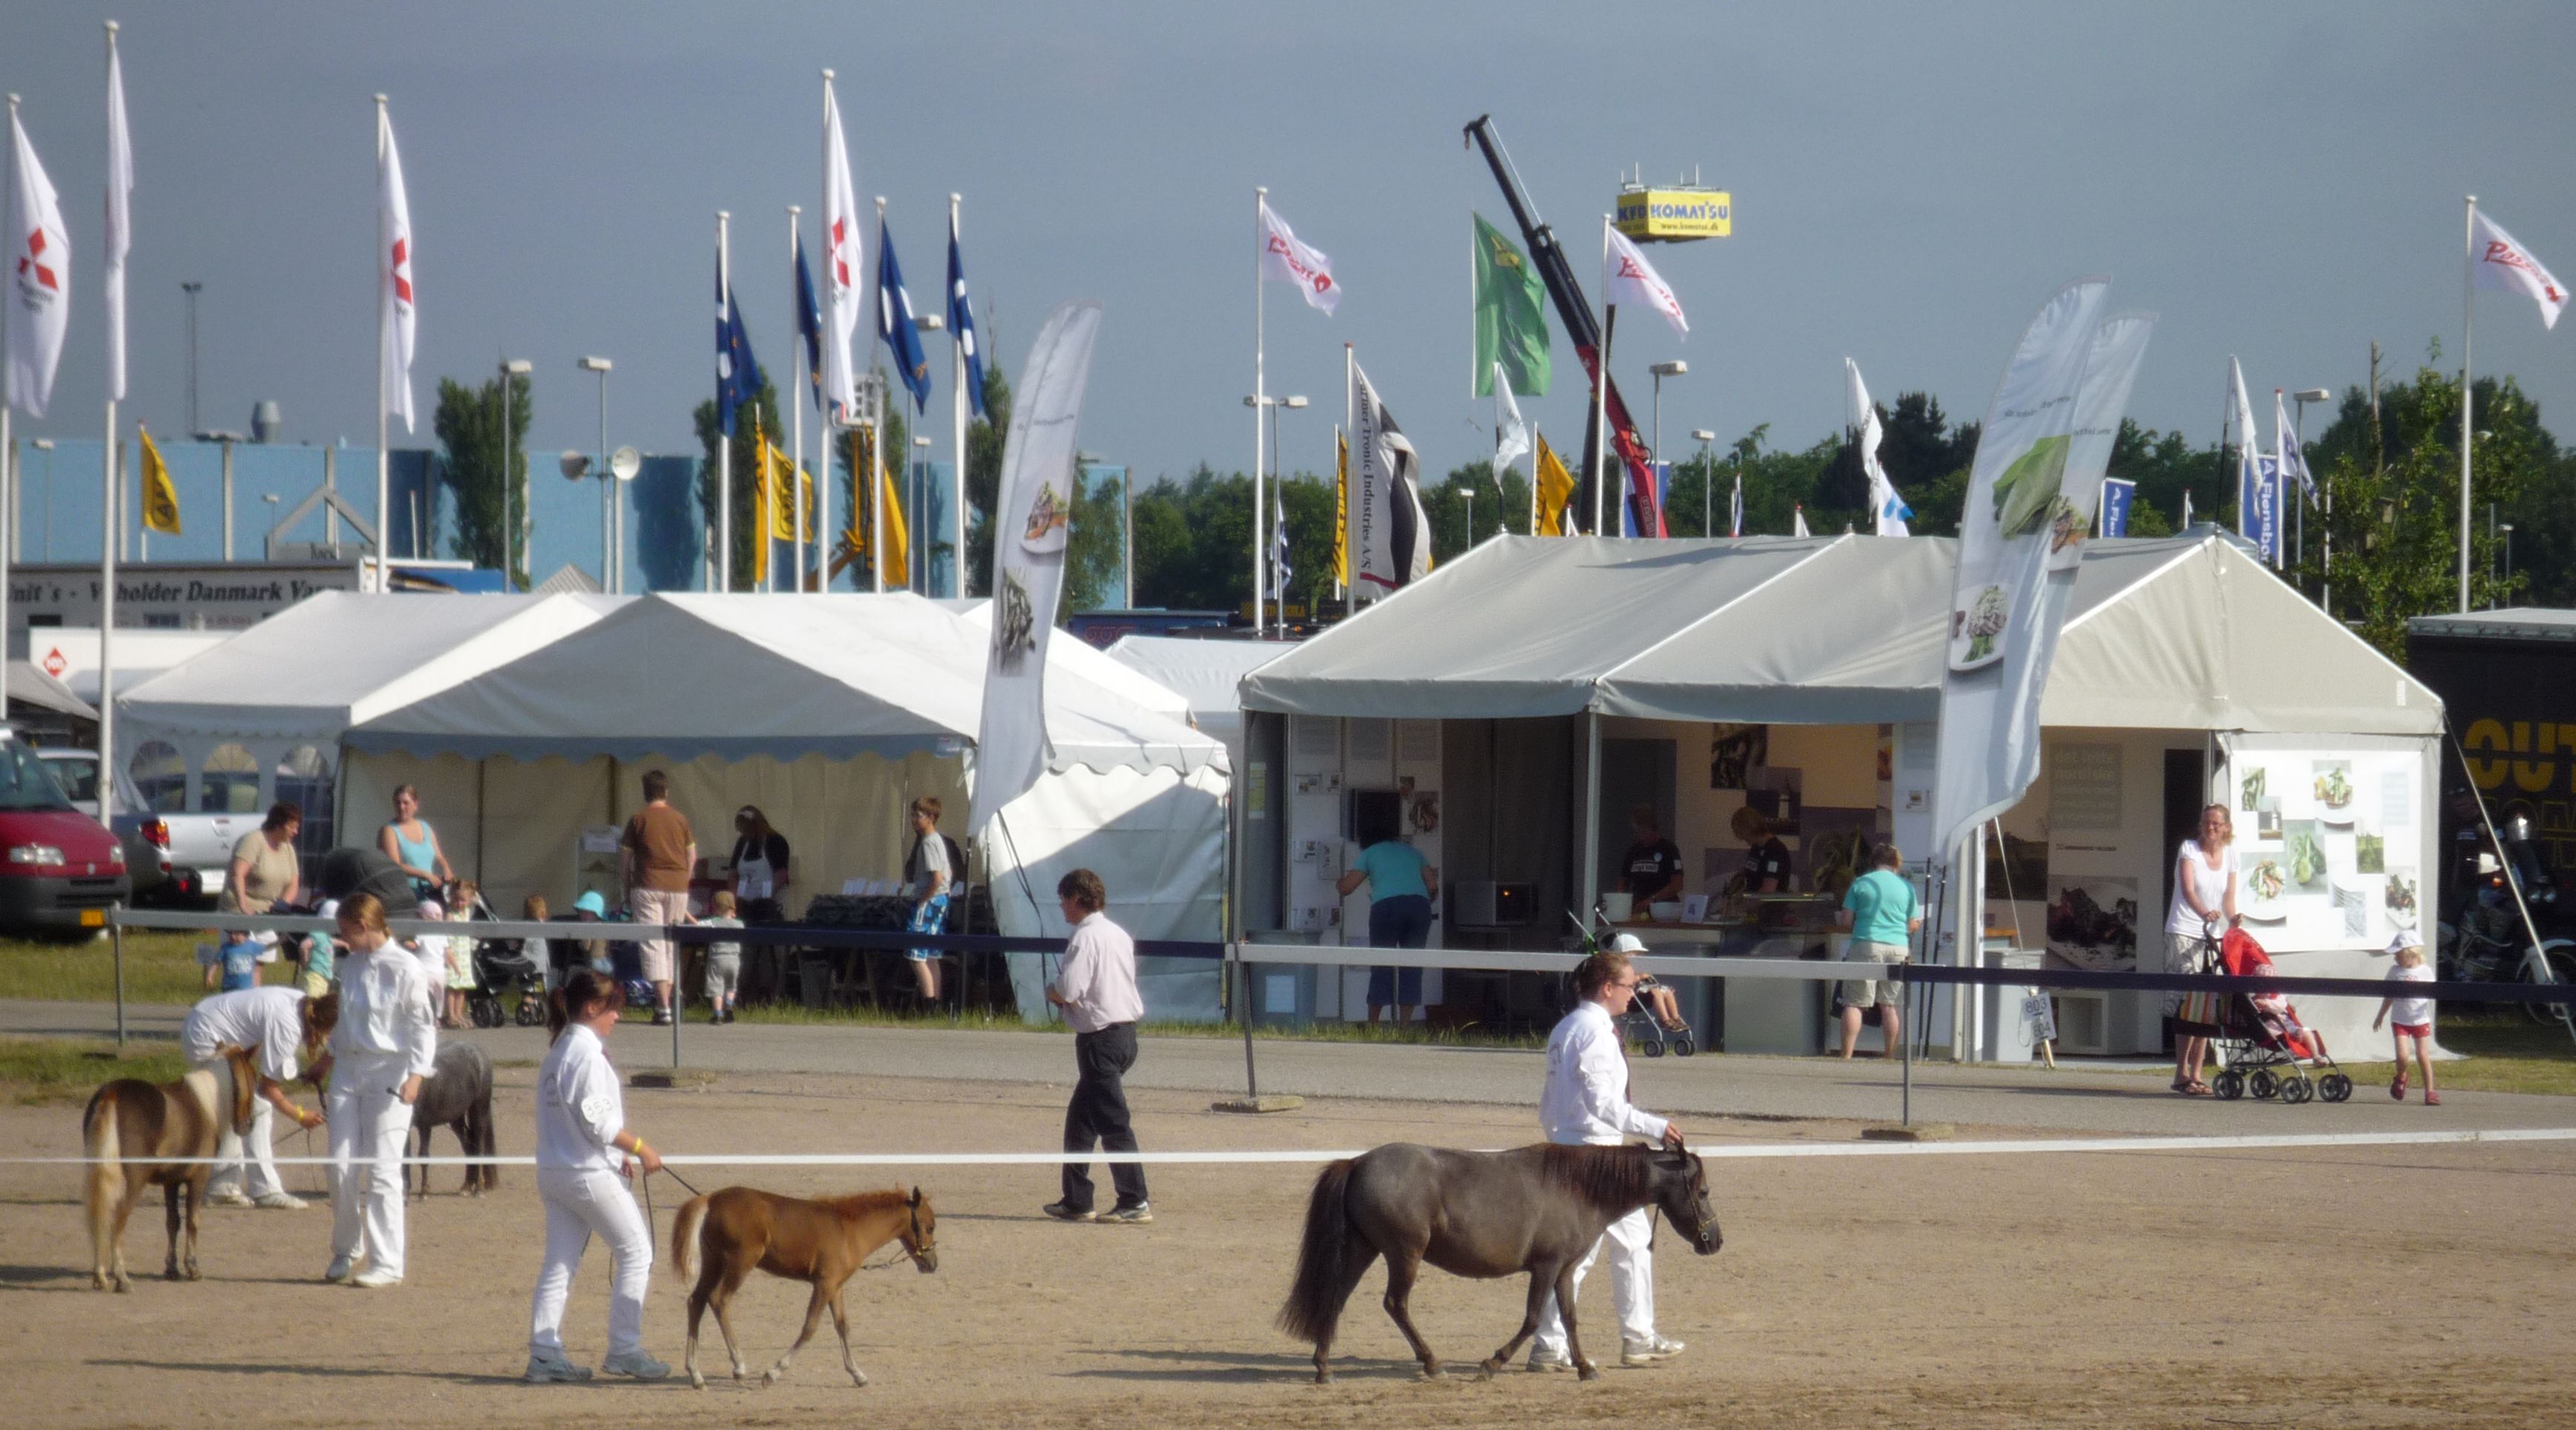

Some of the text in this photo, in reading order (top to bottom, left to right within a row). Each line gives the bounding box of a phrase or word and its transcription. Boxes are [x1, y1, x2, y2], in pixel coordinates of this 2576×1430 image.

[1650, 202, 1729, 220] KOMATSU
[1359, 382, 1376, 569] armer Tronic Industries A/S
[185, 579, 283, 602] Danmark
[2025, 998, 2048, 1013] 803
